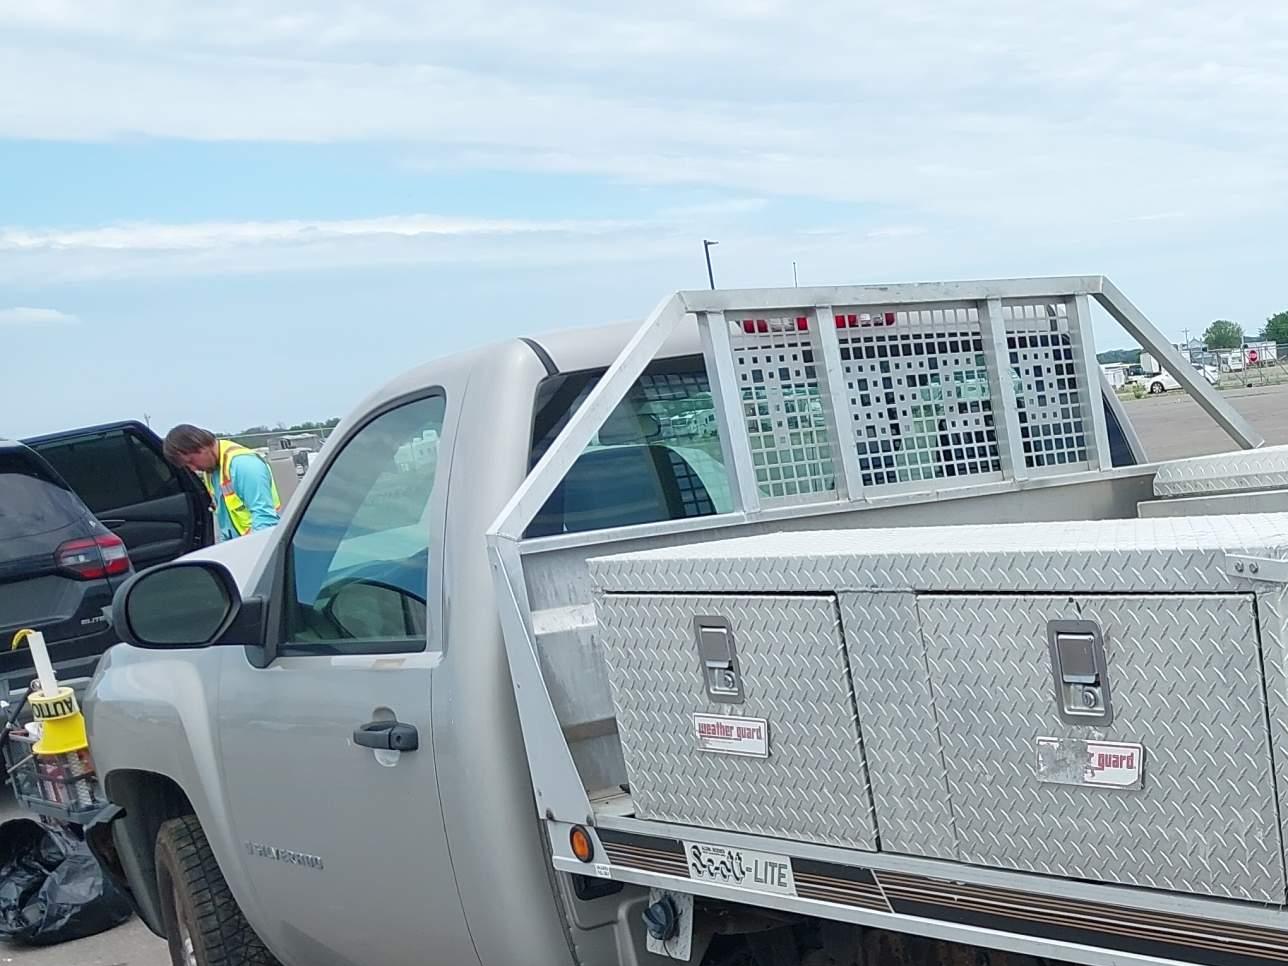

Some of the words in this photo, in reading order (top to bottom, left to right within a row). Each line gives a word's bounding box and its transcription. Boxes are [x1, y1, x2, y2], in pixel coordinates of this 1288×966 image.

[698, 721, 734, 738] weather
[735, 725, 763, 741] guard
[1097, 751, 1135, 771] guard
